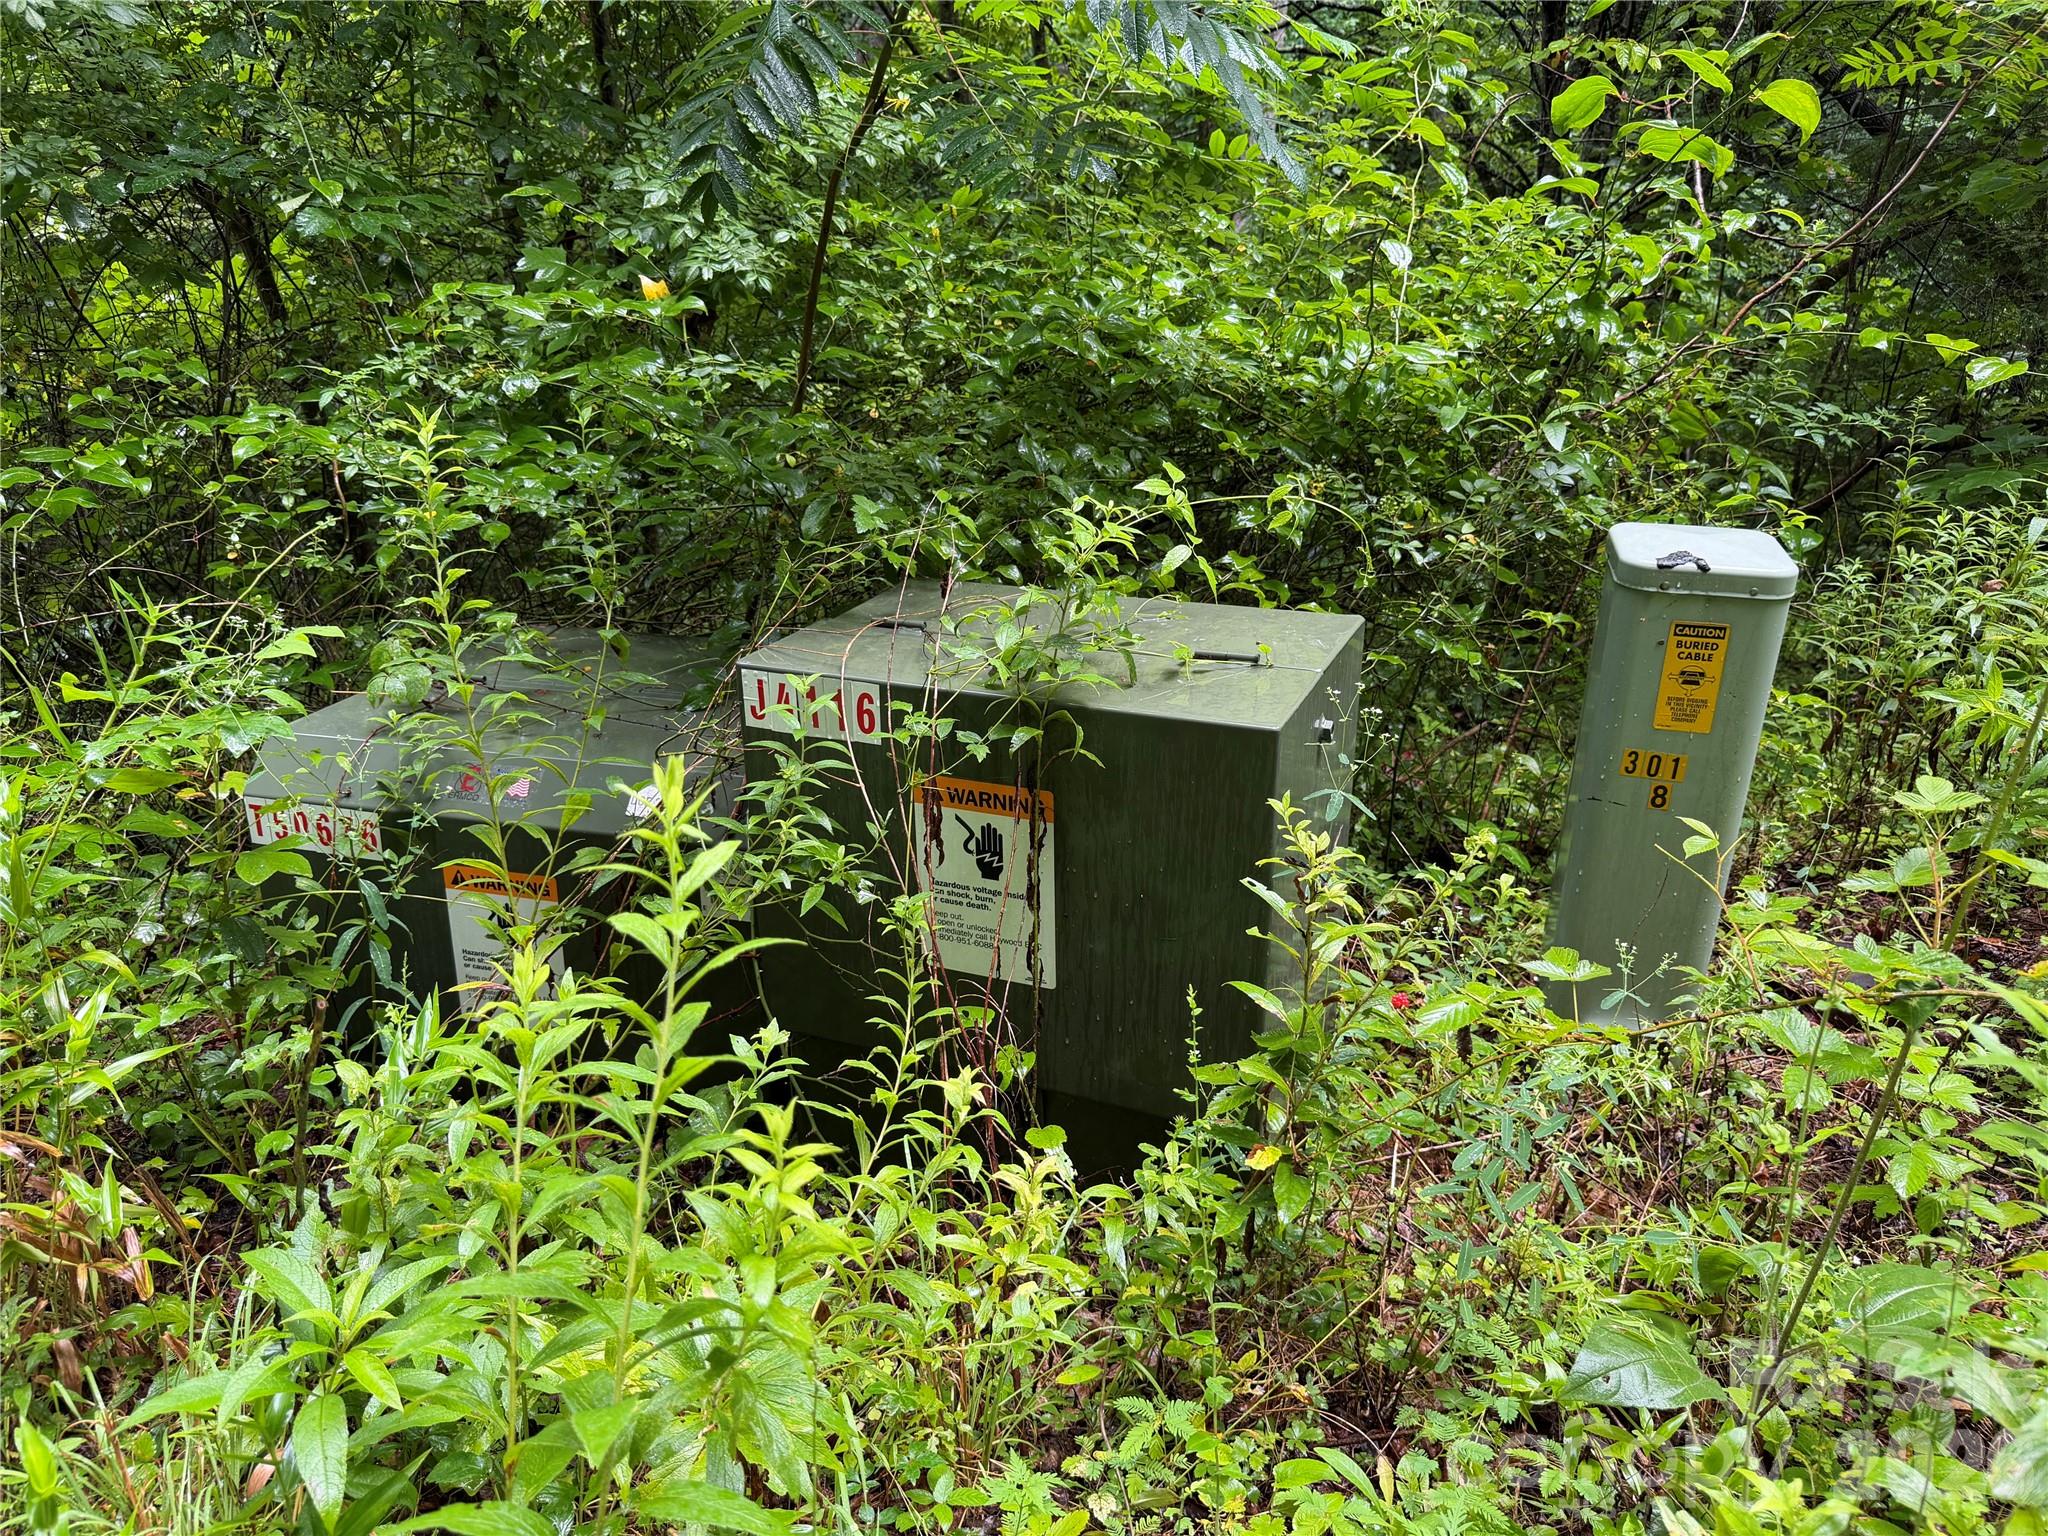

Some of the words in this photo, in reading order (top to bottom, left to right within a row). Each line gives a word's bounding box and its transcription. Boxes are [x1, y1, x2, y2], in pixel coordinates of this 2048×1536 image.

[1675, 626, 1725, 638] CAUTION
[1676, 640, 1719, 651] BURIED
[1677, 652, 1714, 662] CABLE
[1624, 750, 1681, 780] 301
[946, 786, 1046, 816] WARNIN
[1650, 784, 1669, 809] 8
[932, 877, 971, 892] azardous
[972, 885, 1003, 898] voltage
[1005, 891, 1028, 901] nsid
[940, 897, 964, 907] cause
[965, 901, 992, 912] death.
[946, 890, 973, 902] shock,
[975, 895, 997, 905] burn,
[935, 910, 949, 919] eep
[937, 932, 995, 949] -800-951-6088
[990, 935, 1023, 947] Hywood
